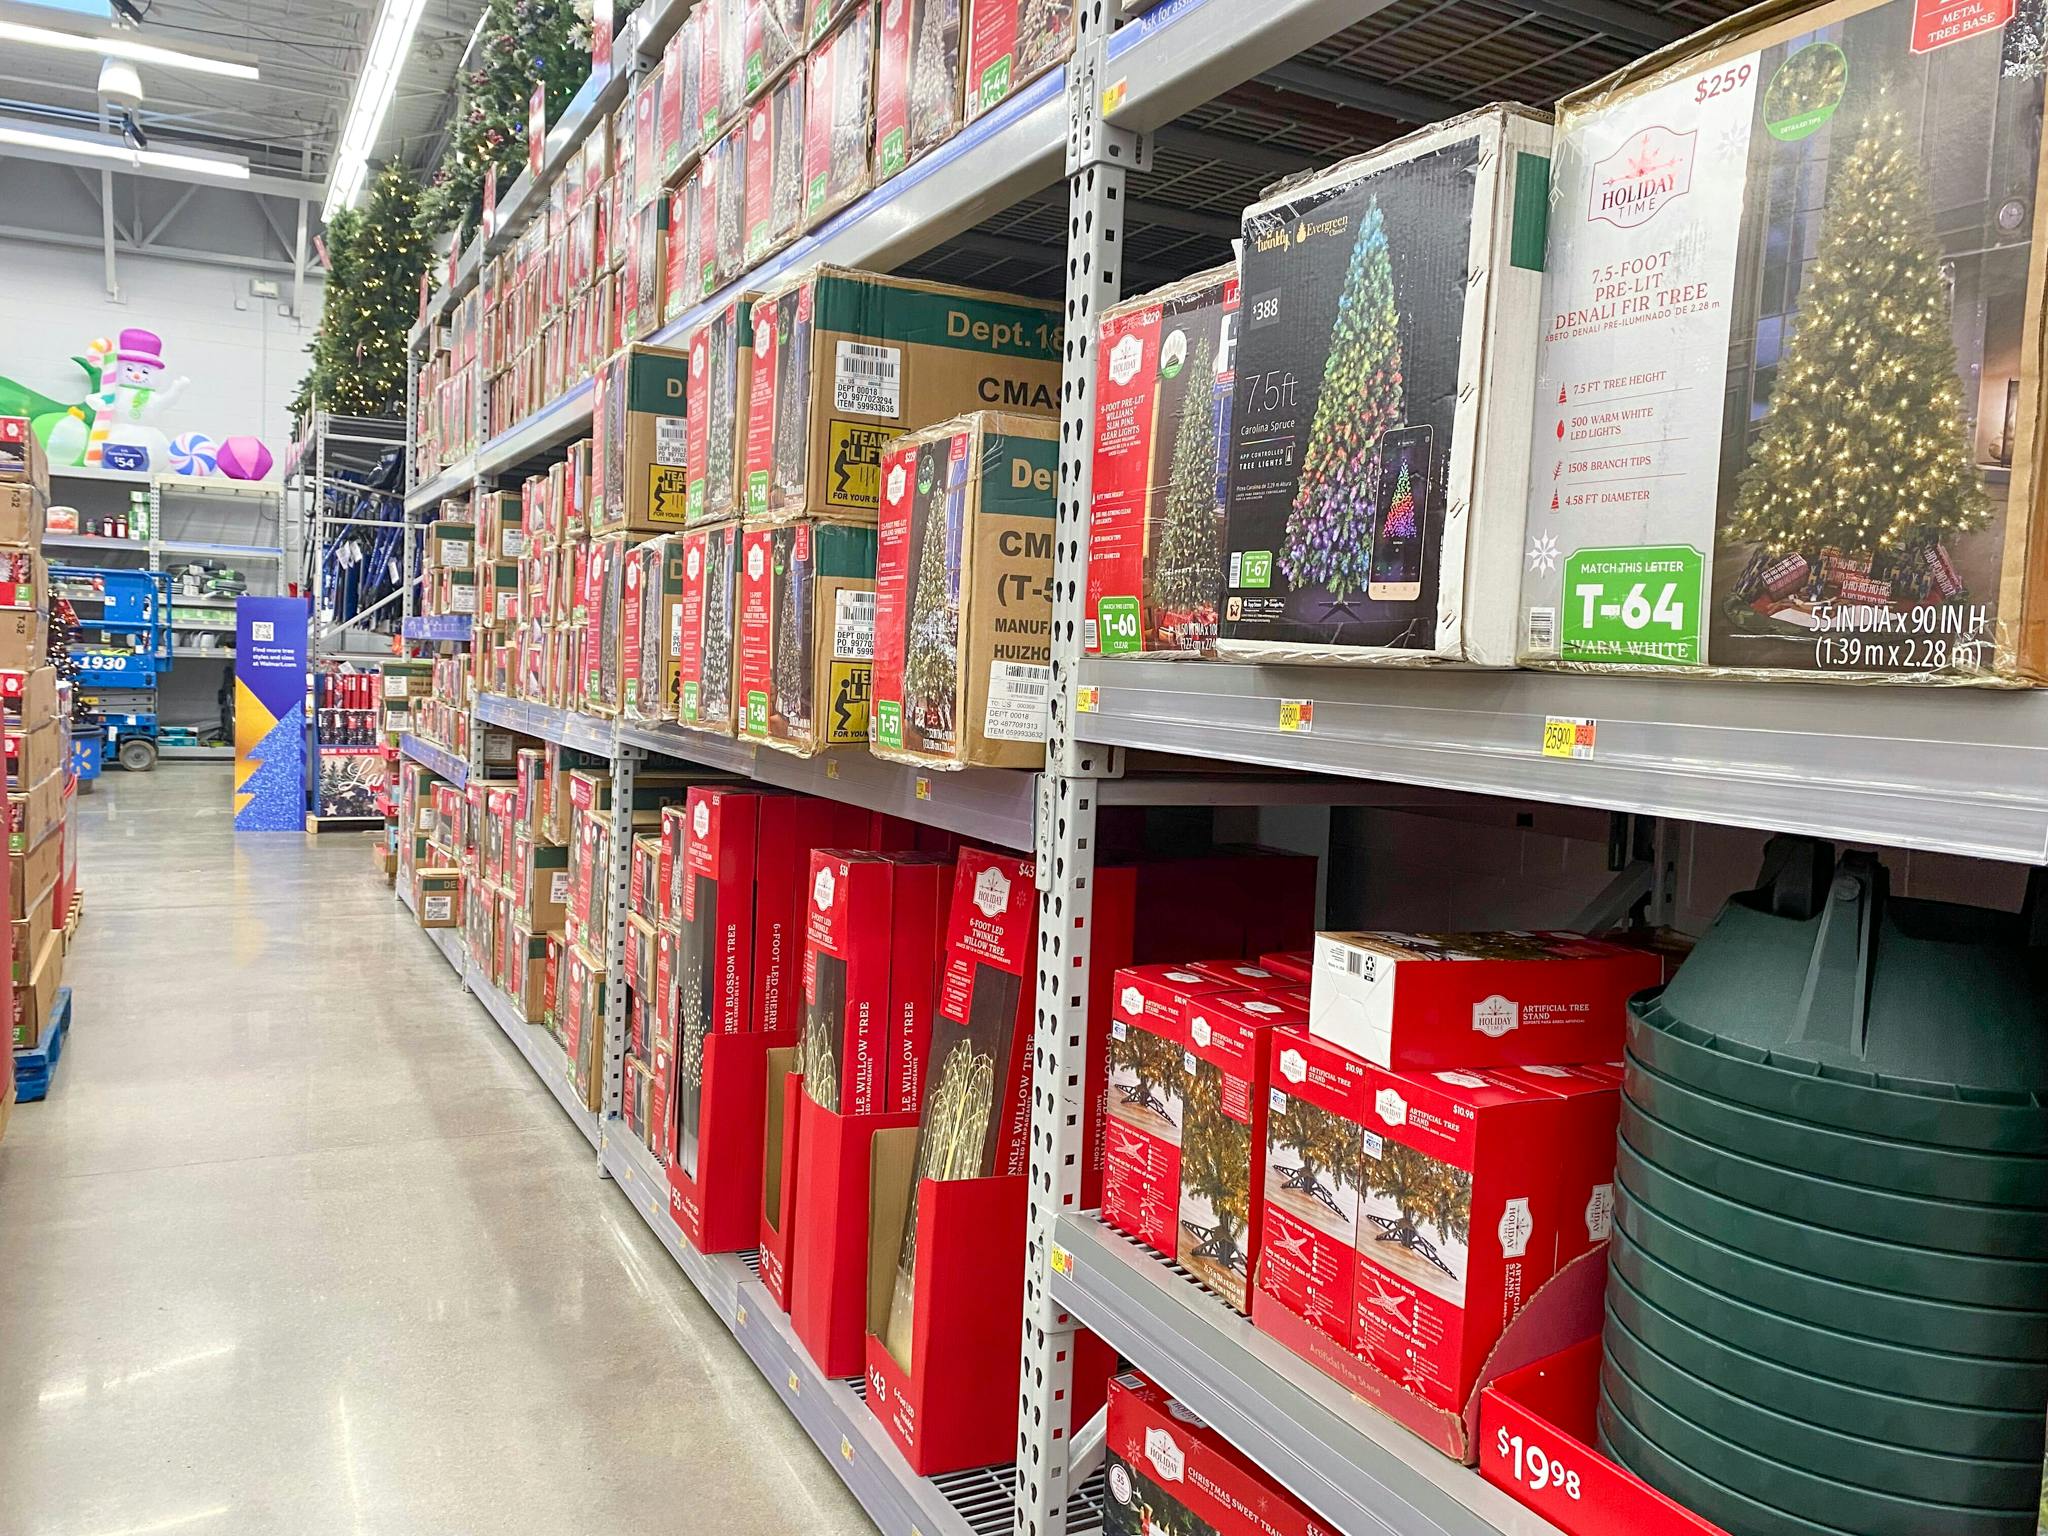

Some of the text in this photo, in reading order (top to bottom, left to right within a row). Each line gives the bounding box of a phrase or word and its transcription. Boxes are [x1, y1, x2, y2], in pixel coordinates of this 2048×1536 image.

[1141, 6, 1171, 33] Ask for
[1941, 4, 1984, 25] METAL
[1927, 12, 1997, 43] TREE BASE
[1694, 63, 1752, 104] $259
[1600, 174, 1676, 211] HOLIDAY
[1617, 197, 1657, 219] TIME
[1307, 215, 1348, 237] Evergreen
[1592, 251, 1672, 284] 7.5-FOOT
[1595, 273, 1664, 302] PRE-LIT
[1253, 298, 1278, 321] $388
[1555, 282, 1708, 330] DENALI FIR TREE
[1572, 300, 1720, 338] DENALI PRE-ILUMINADO DE 2.28 m
[838, 384, 877, 396] DEPT 00018
[978, 377, 1062, 410] CMA
[1245, 370, 1299, 414] 7.5ft
[1573, 370, 1667, 395] 7.5 FT TREE HEIGHT
[838, 392, 847, 400] PO
[838, 400, 854, 408] ITEM
[1241, 419, 1296, 436] Carolina Spruce
[1571, 407, 1653, 429] 500 WARM WHITE
[1101, 426, 1140, 442] CLEAR LIGHTS
[1570, 425, 1621, 441] LED LIGHTS
[1239, 458, 1283, 470] TREE LIGHTS
[1251, 449, 1284, 459] CONTROLLED
[1567, 455, 1652, 474] 1508 BRANCH TIPS
[833, 492, 848, 500] FOR
[851, 494, 870, 502] YOUR
[1565, 490, 1650, 507] 4.58 FT DIAMETER
[1245, 561, 1269, 577] T-67
[1580, 560, 1685, 574] MATCH THIS LETTER
[1575, 582, 1685, 632] T-64
[1102, 614, 1136, 637] T-60
[1808, 604, 1987, 636] 55 IN DIA x 90 IN H
[1114, 641, 1128, 649] CLEAR
[1626, 640, 1690, 659] WHITE
[1815, 637, 1862, 669] (1.39
[1865, 645, 1885, 666] m
[1887, 646, 1898, 666] x
[1903, 639, 1945, 669] 2.28
[881, 714, 899, 734] T-57
[1010, 712, 1029, 720] 00018
[1018, 862, 1035, 878] $43
[978, 890, 1004, 905] HOLIDAY
[969, 918, 1004, 936] 6-FOOT LED
[972, 928, 999, 945] TWINKLE
[963, 935, 1005, 957] WILLOW TREE
[726, 924, 736, 1007] TREE BLOSSOM
[769, 923, 781, 1031] 6-FOOT LED CHERRY
[859, 1001, 870, 1035] TREE
[904, 1001, 914, 1035] TREE
[1168, 1007, 1179, 1016] TREE
[1522, 1003, 1590, 1014] ARTIFICIAL TREE
[1522, 1011, 1551, 1021] STAND
[1478, 1015, 1512, 1027] HOLIDAY
[1233, 1040, 1245, 1050] TREE
[857, 1038, 869, 1094] WILLOW
[902, 1038, 914, 1094] WILLOW
[1309, 1066, 1352, 1088] ARTIFICIAL TREE
[1345, 1063, 1363, 1076] $10.98
[1308, 1073, 1326, 1084] STAND
[1013, 1075, 1030, 1135] WILLOW
[1453, 1104, 1474, 1120] $10.98
[1409, 1107, 1460, 1132] ARTIFICIAL TREE
[1409, 1114, 1430, 1127] STAND
[1507, 1207, 1516, 1249] HOLIDAY
[1360, 1260, 1401, 1289] Assemble tree
[1508, 1263, 1516, 1298] STAND
[1310, 1343, 1381, 1397] Artificial Tree Stand
[869, 1363, 886, 1402] $43
[1150, 1447, 1179, 1475] HOLIDAY
[1188, 1467, 1260, 1524] CHRISTMAS SWEET
